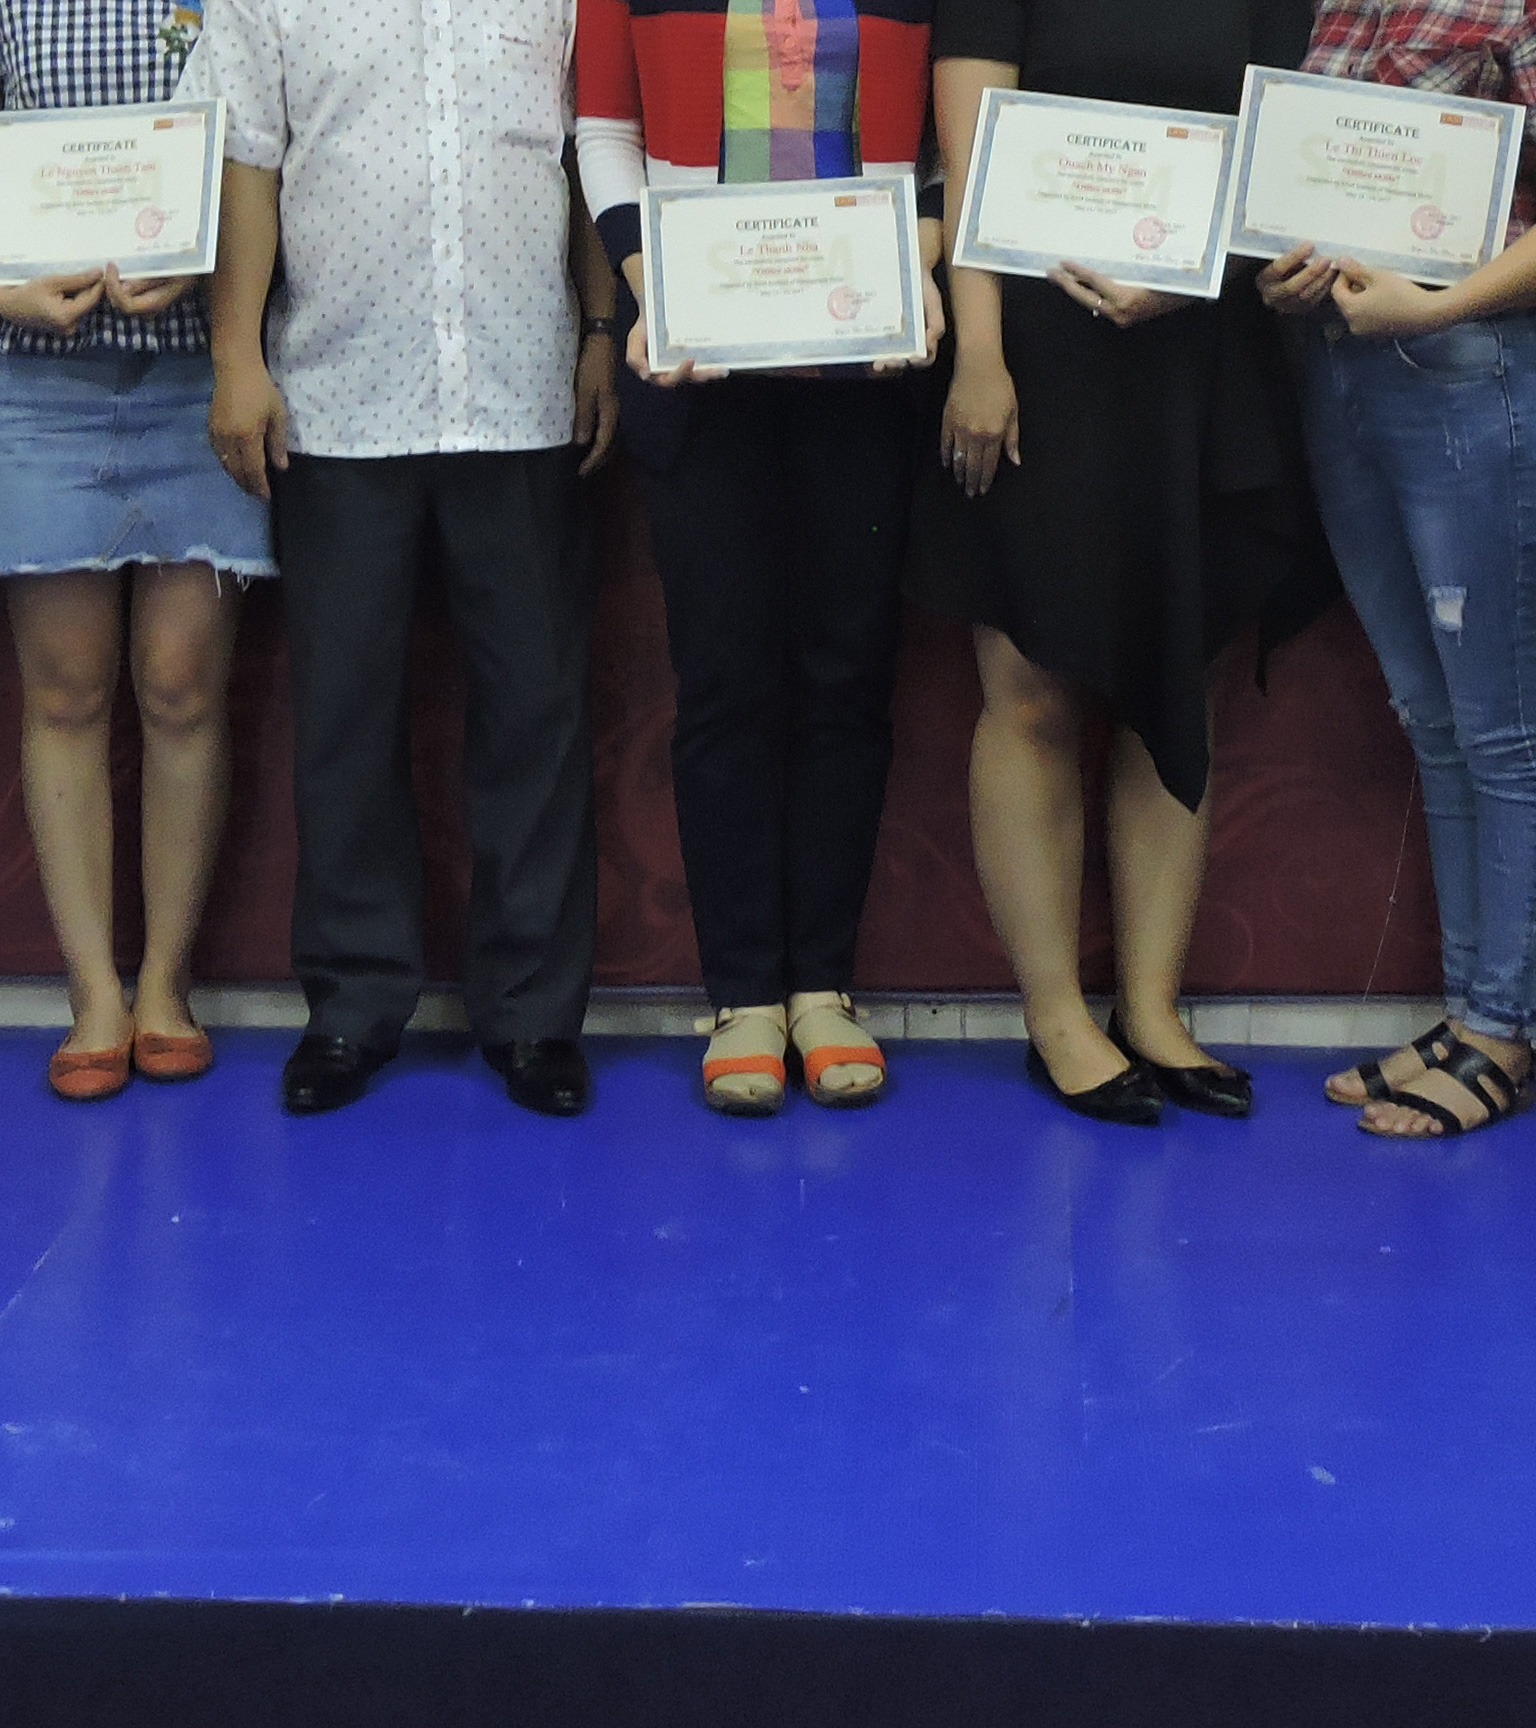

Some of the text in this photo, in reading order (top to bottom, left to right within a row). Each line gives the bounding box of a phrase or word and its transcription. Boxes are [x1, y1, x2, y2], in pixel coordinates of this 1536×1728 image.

[1336, 116, 1421, 139] CERTIFICATE
[62, 139, 138, 153] CERTIFICATE
[1066, 133, 1147, 153] CERTIFICATE
[735, 217, 819, 231] CERTIFICATE
